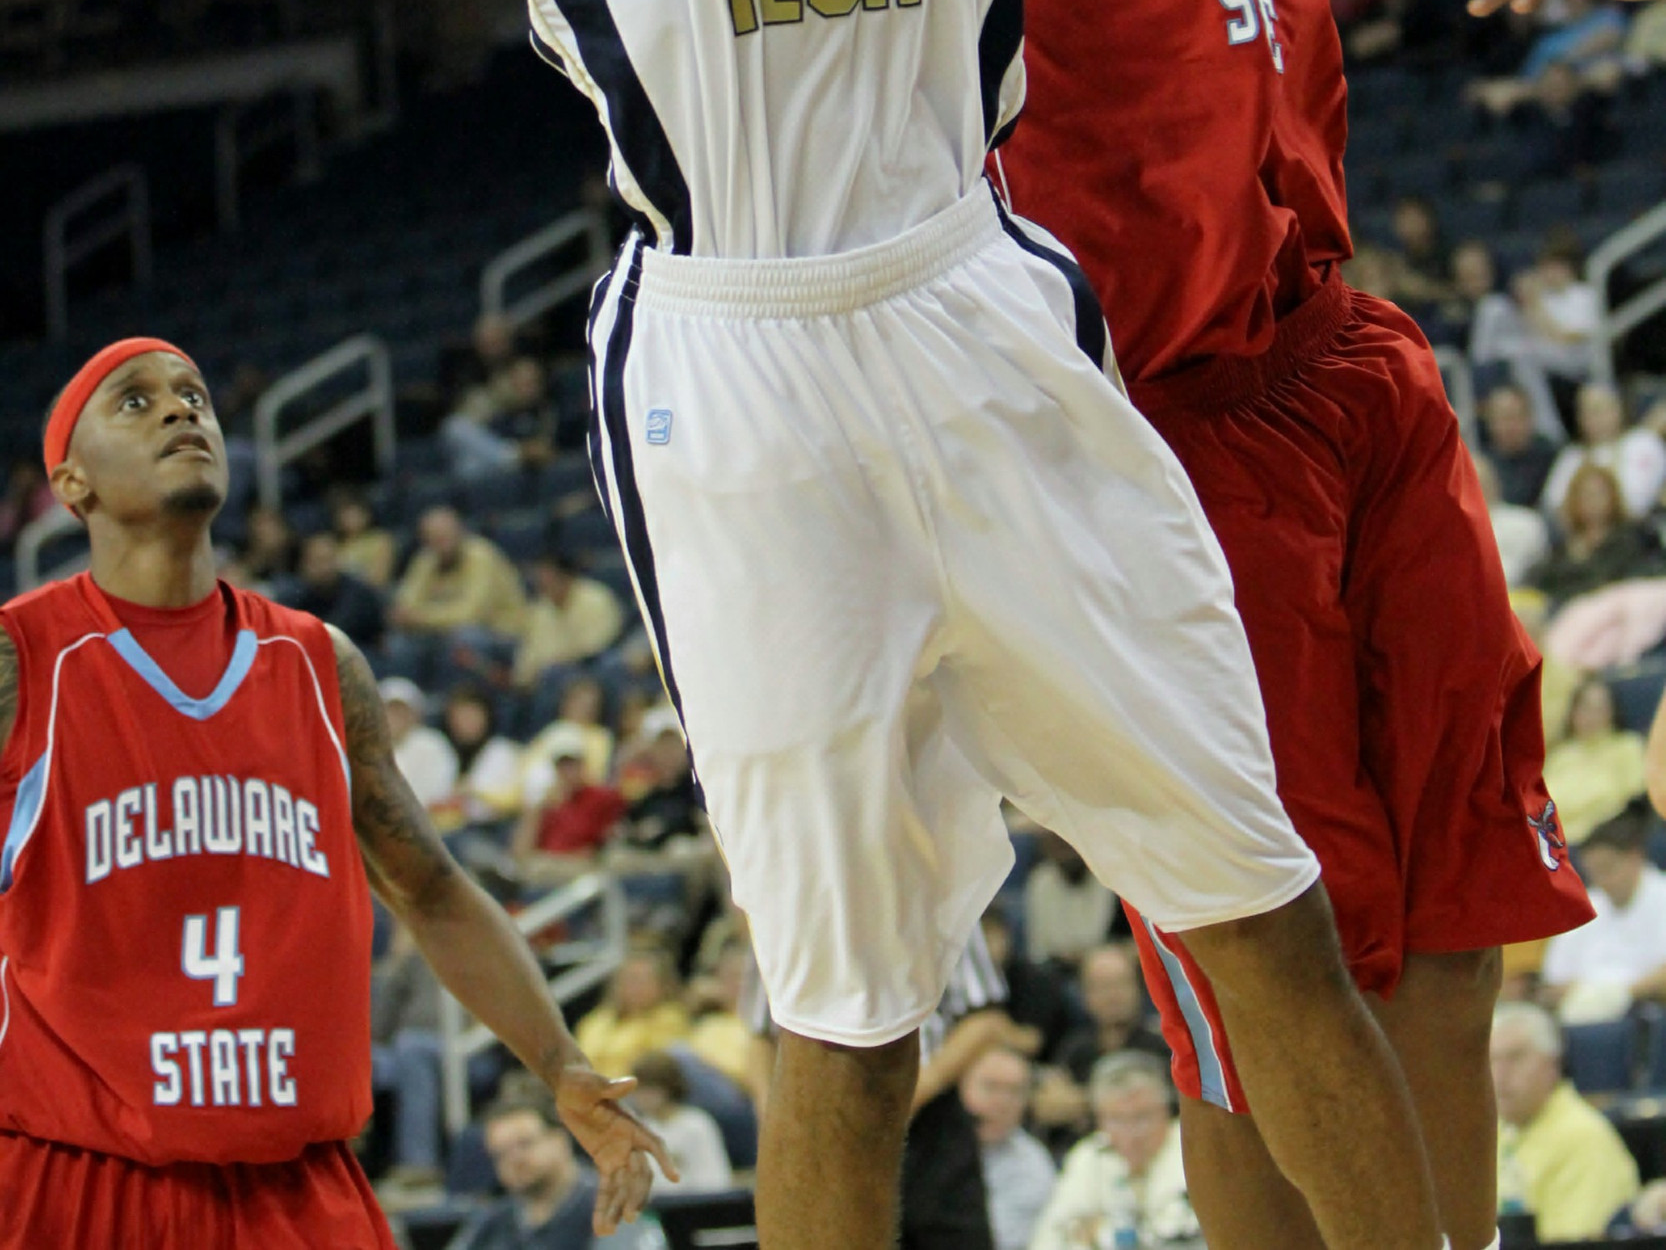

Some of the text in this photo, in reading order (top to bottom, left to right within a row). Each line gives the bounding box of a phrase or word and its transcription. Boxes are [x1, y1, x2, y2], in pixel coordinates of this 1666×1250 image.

[85, 775, 330, 884] DELAWARE
[181, 906, 244, 1007] 4
[150, 1028, 298, 1107] STATE
